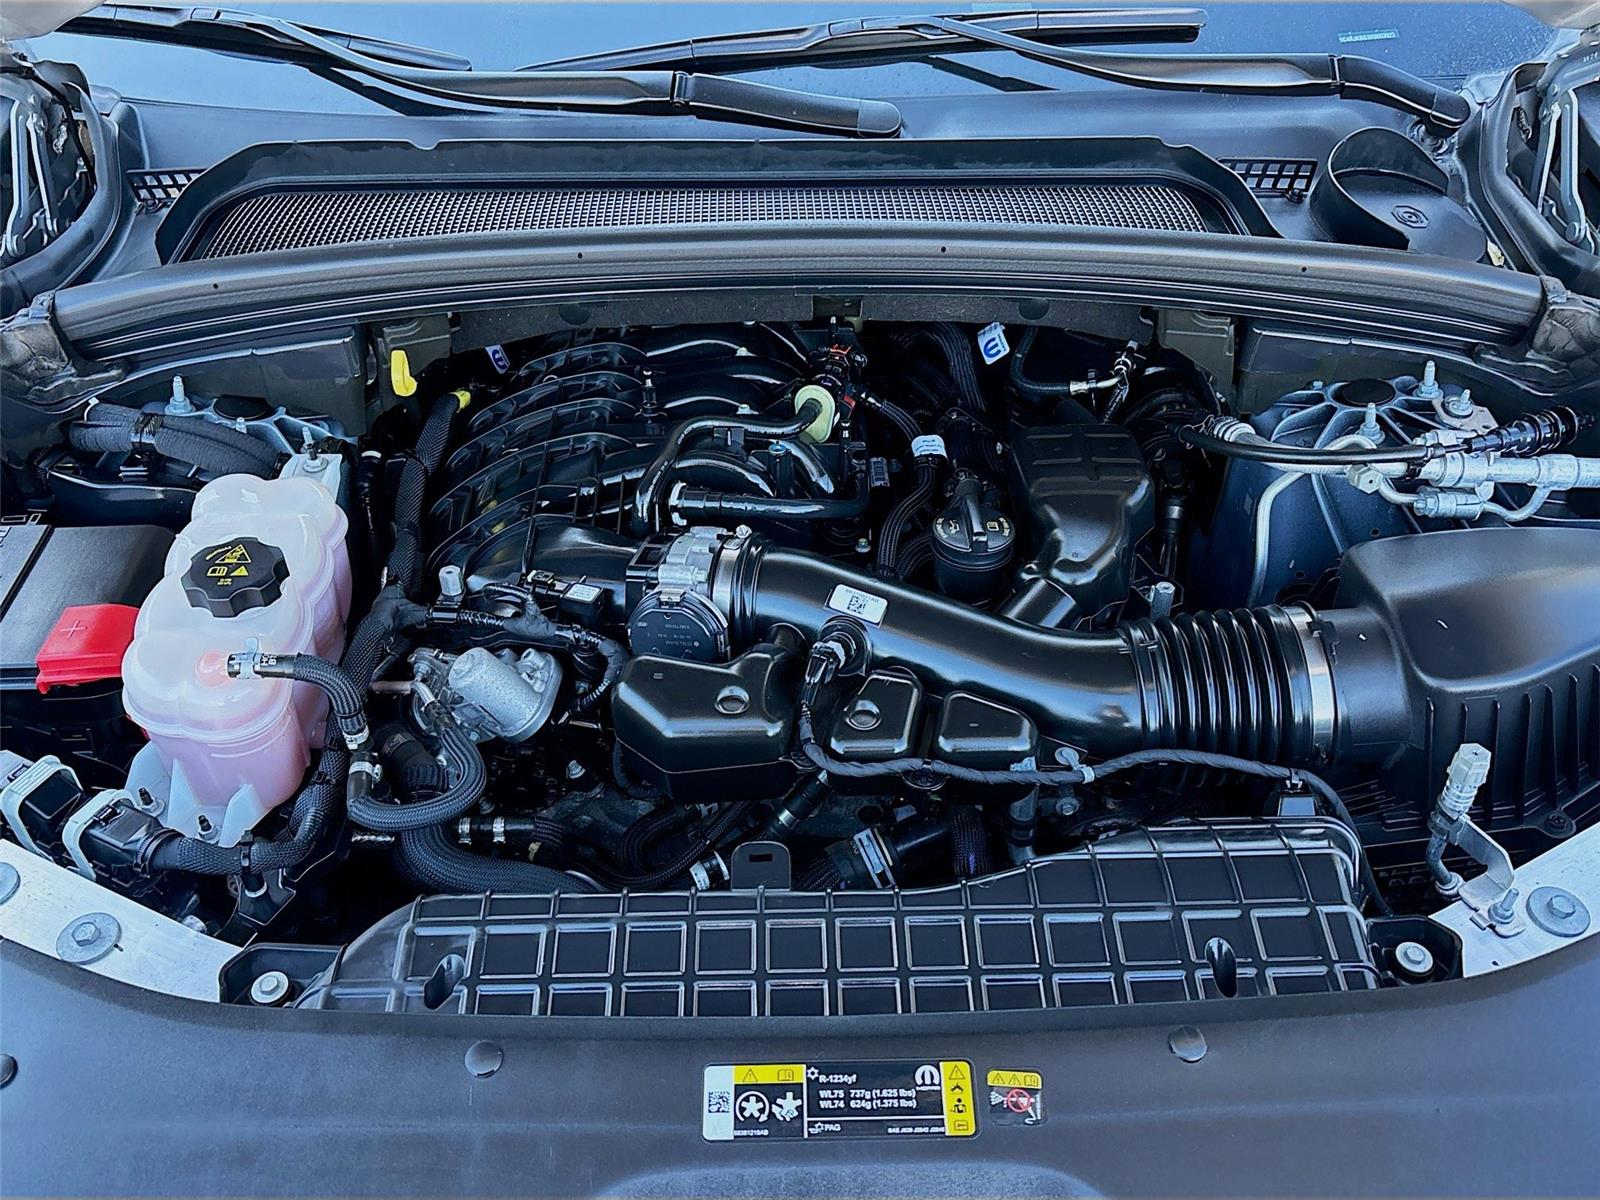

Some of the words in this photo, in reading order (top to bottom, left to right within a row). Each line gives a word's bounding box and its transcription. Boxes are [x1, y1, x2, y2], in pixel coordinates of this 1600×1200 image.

[819, 1074, 857, 1085] R-1234yf
[819, 1090, 845, 1099] WL75
[849, 1089, 871, 1100] 737g
[872, 1089, 898, 1099] (1.625
[899, 1089, 917, 1099] lbs)
[819, 1100, 845, 1109] WL74
[849, 1099, 872, 1110] 624g
[872, 1099, 899, 1109] (1.375
[900, 1099, 917, 1109] lbs)
[824, 1123, 841, 1131] PAG
